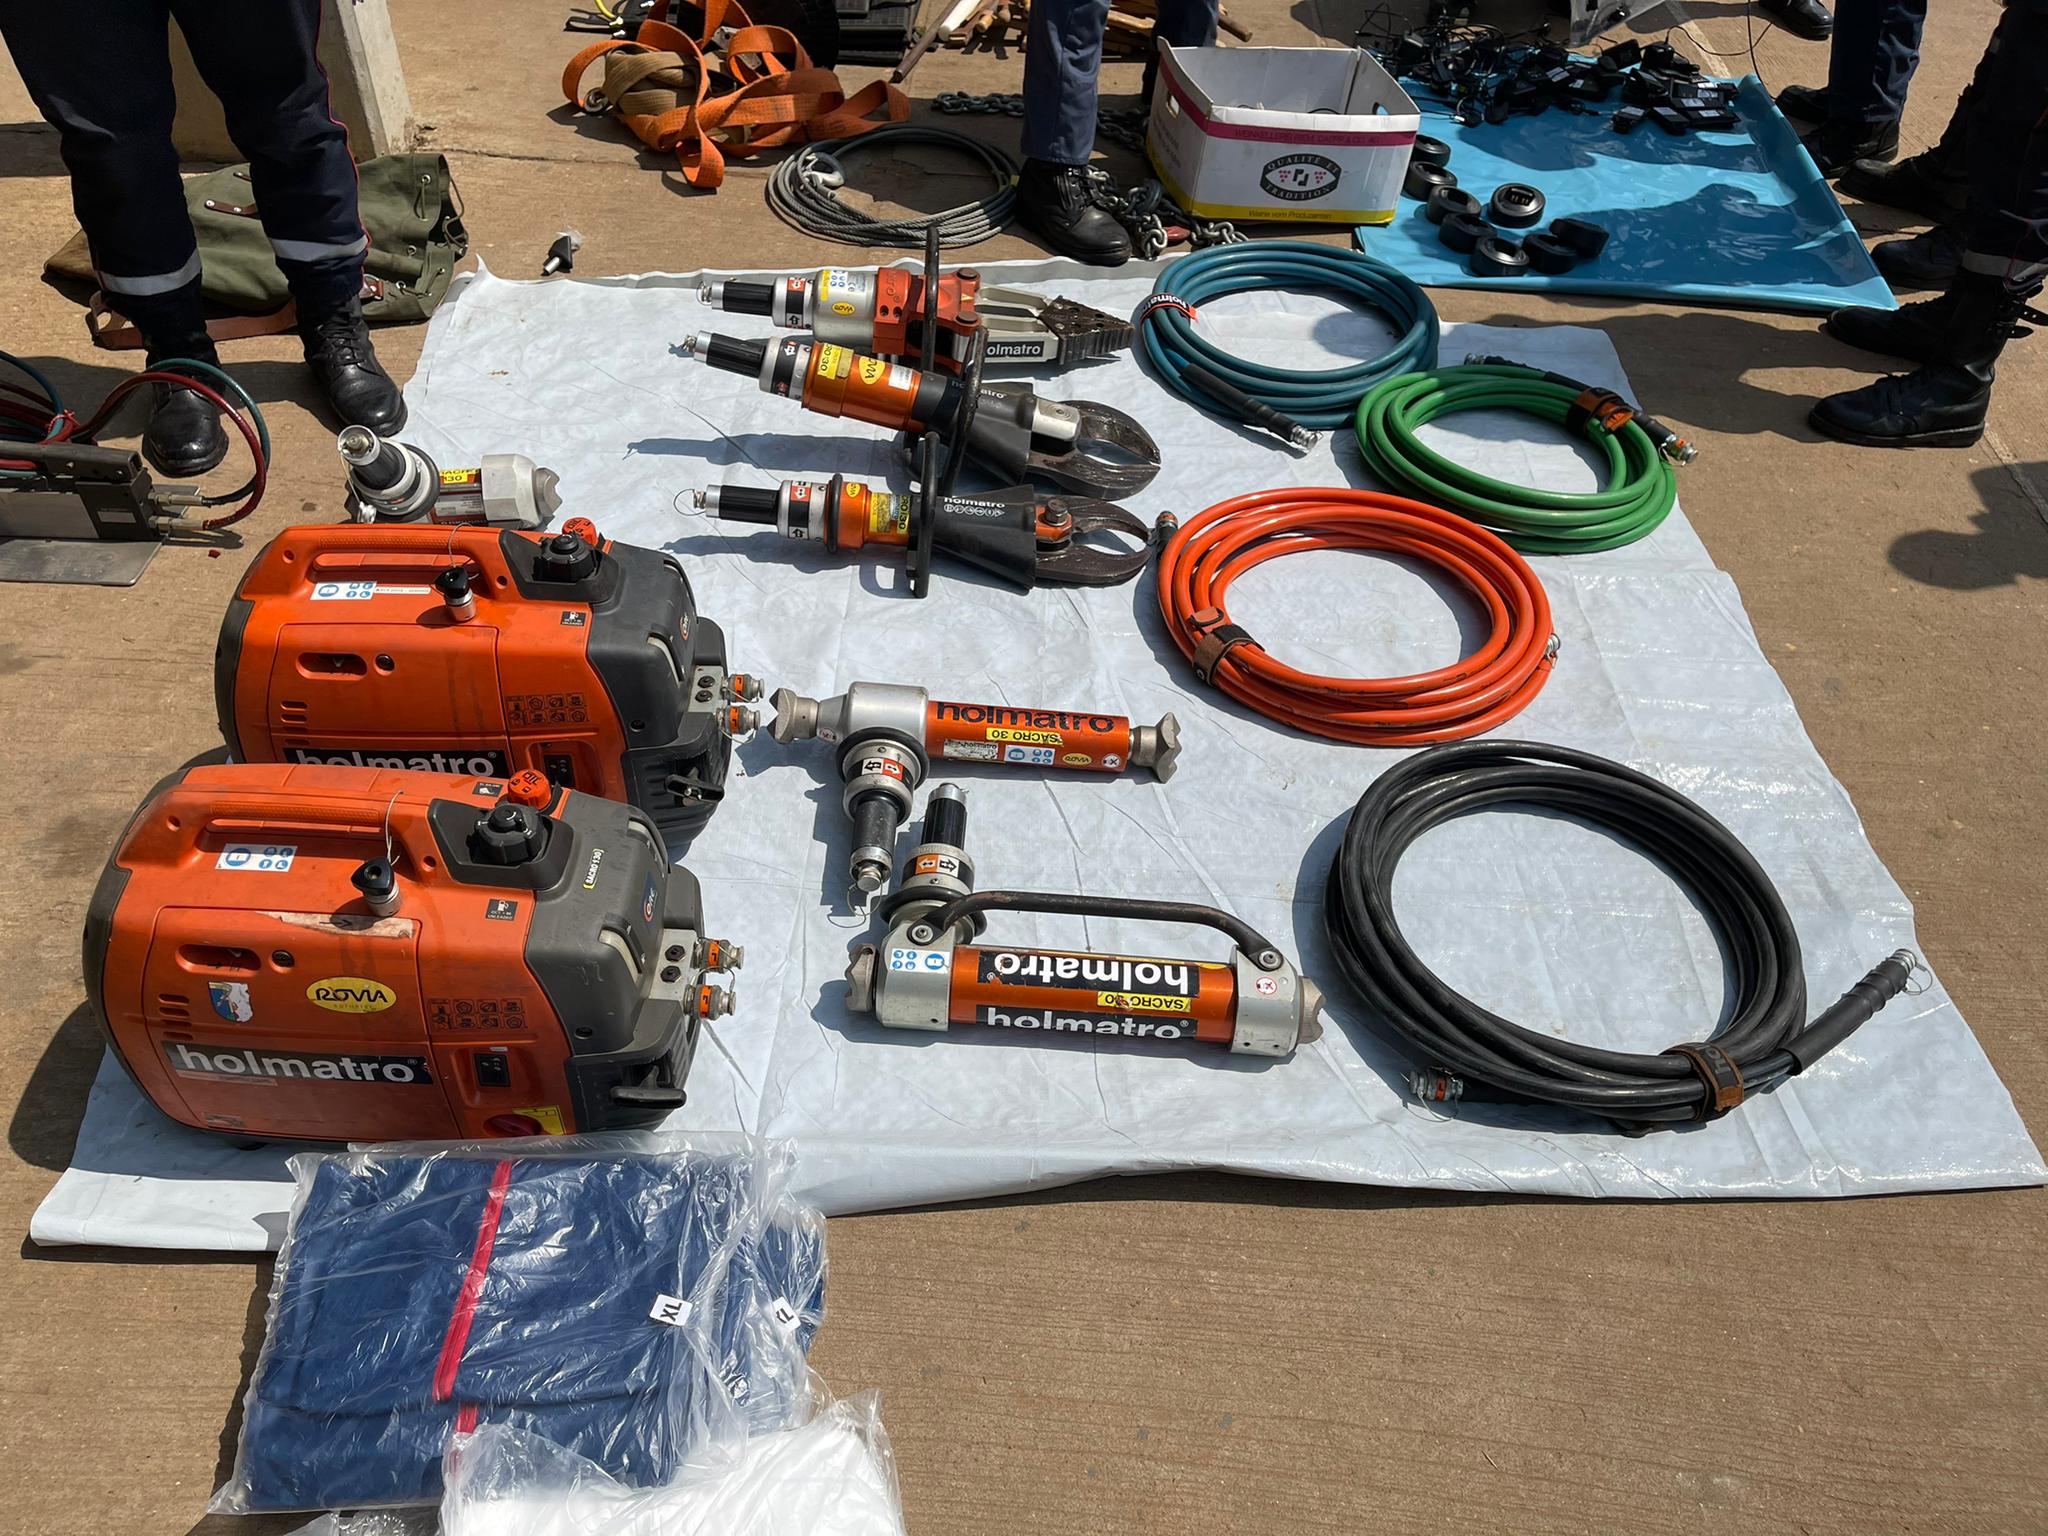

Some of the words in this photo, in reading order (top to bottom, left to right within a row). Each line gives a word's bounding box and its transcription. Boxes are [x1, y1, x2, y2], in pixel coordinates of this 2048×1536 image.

[1326, 161, 1340, 173] ET
[1265, 184, 1330, 200] TRADITION
[1288, 210, 1332, 220] Produzenten
[986, 343, 1041, 355] olmatro
[936, 702, 1115, 733] holmatro
[991, 729, 1009, 739] 30
[1012, 731, 1059, 743] SACRO
[522, 770, 542, 786] OIL
[585, 863, 599, 884] SACRO
[994, 952, 1188, 995] holmatro
[315, 987, 388, 1003] ROVIA
[1131, 996, 1184, 1009] SACRO
[987, 1007, 1182, 1040] holmatro
[176, 1044, 415, 1083] holmatro
[660, 1302, 683, 1322] XL
